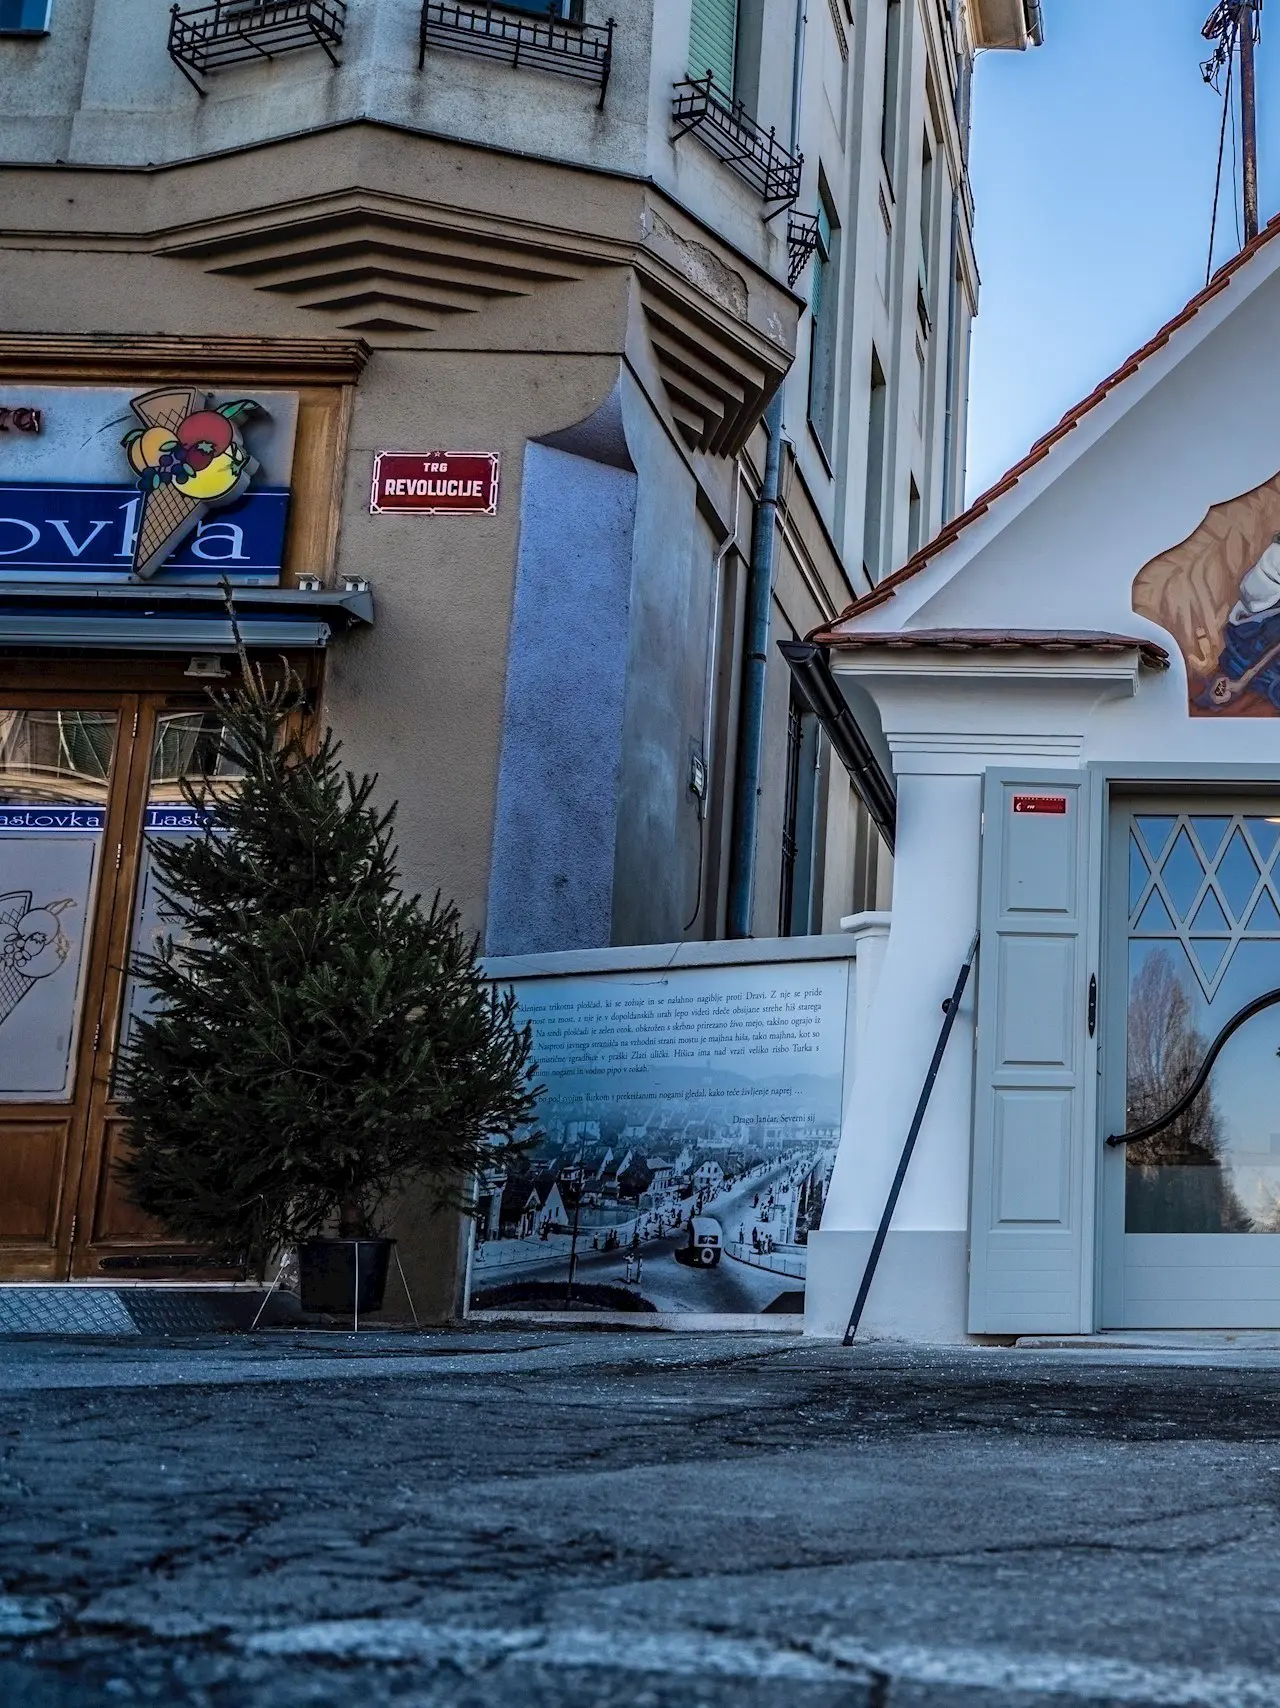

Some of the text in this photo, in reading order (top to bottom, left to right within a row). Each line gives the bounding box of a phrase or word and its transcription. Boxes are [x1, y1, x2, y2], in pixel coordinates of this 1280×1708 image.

[423, 462, 448, 473] TRG
[384, 479, 484, 497] REVOLUCIJE
[606, 1000, 612, 1008] ki
[726, 992, 743, 1003] proti
[746, 992, 767, 1000] Dravi.
[780, 990, 790, 1000] nje
[804, 988, 823, 999] pride
[596, 1015, 602, 1023] je
[674, 1009, 688, 1019] lepo
[691, 1008, 710, 1016] videti
[762, 1004, 782, 1012] strehe
[785, 1003, 796, 1011] hiš
[798, 1003, 822, 1012] starega
[536, 1029, 546, 1037] Na
[591, 1027, 597, 1036] je
[697, 1021, 728, 1032] prirezano
[729, 1020, 743, 1028] živo
[791, 1018, 812, 1027] ograjo
[538, 1042, 565, 1053] Nasproti
[630, 1037, 656, 1046] vzhodni
[658, 1037, 676, 1045] strani
[700, 1035, 707, 1044] je
[708, 1034, 733, 1043] majhna
[752, 1032, 767, 1040] tako
[799, 1030, 810, 1038] kot
[631, 1051, 646, 1060] Zlati
[674, 1049, 695, 1058] Hišica
[714, 1047, 727, 1056] nad
[730, 1047, 745, 1055] vrati
[749, 1045, 769, 1054] veliko
[772, 1045, 789, 1053] risbo
[792, 1044, 812, 1052] Turka
[607, 1066, 621, 1076] pipo
[548, 1094, 561, 1103] pod
[585, 1093, 609, 1101] Turkom
[660, 1090, 683, 1100] nogami
[709, 1088, 725, 1097] kako
[727, 1088, 740, 1096] teče
[741, 1087, 769, 1097] življenje
[771, 1087, 792, 1097] naprej
[733, 1113, 816, 1125] Drago Jančar, Severni sij
